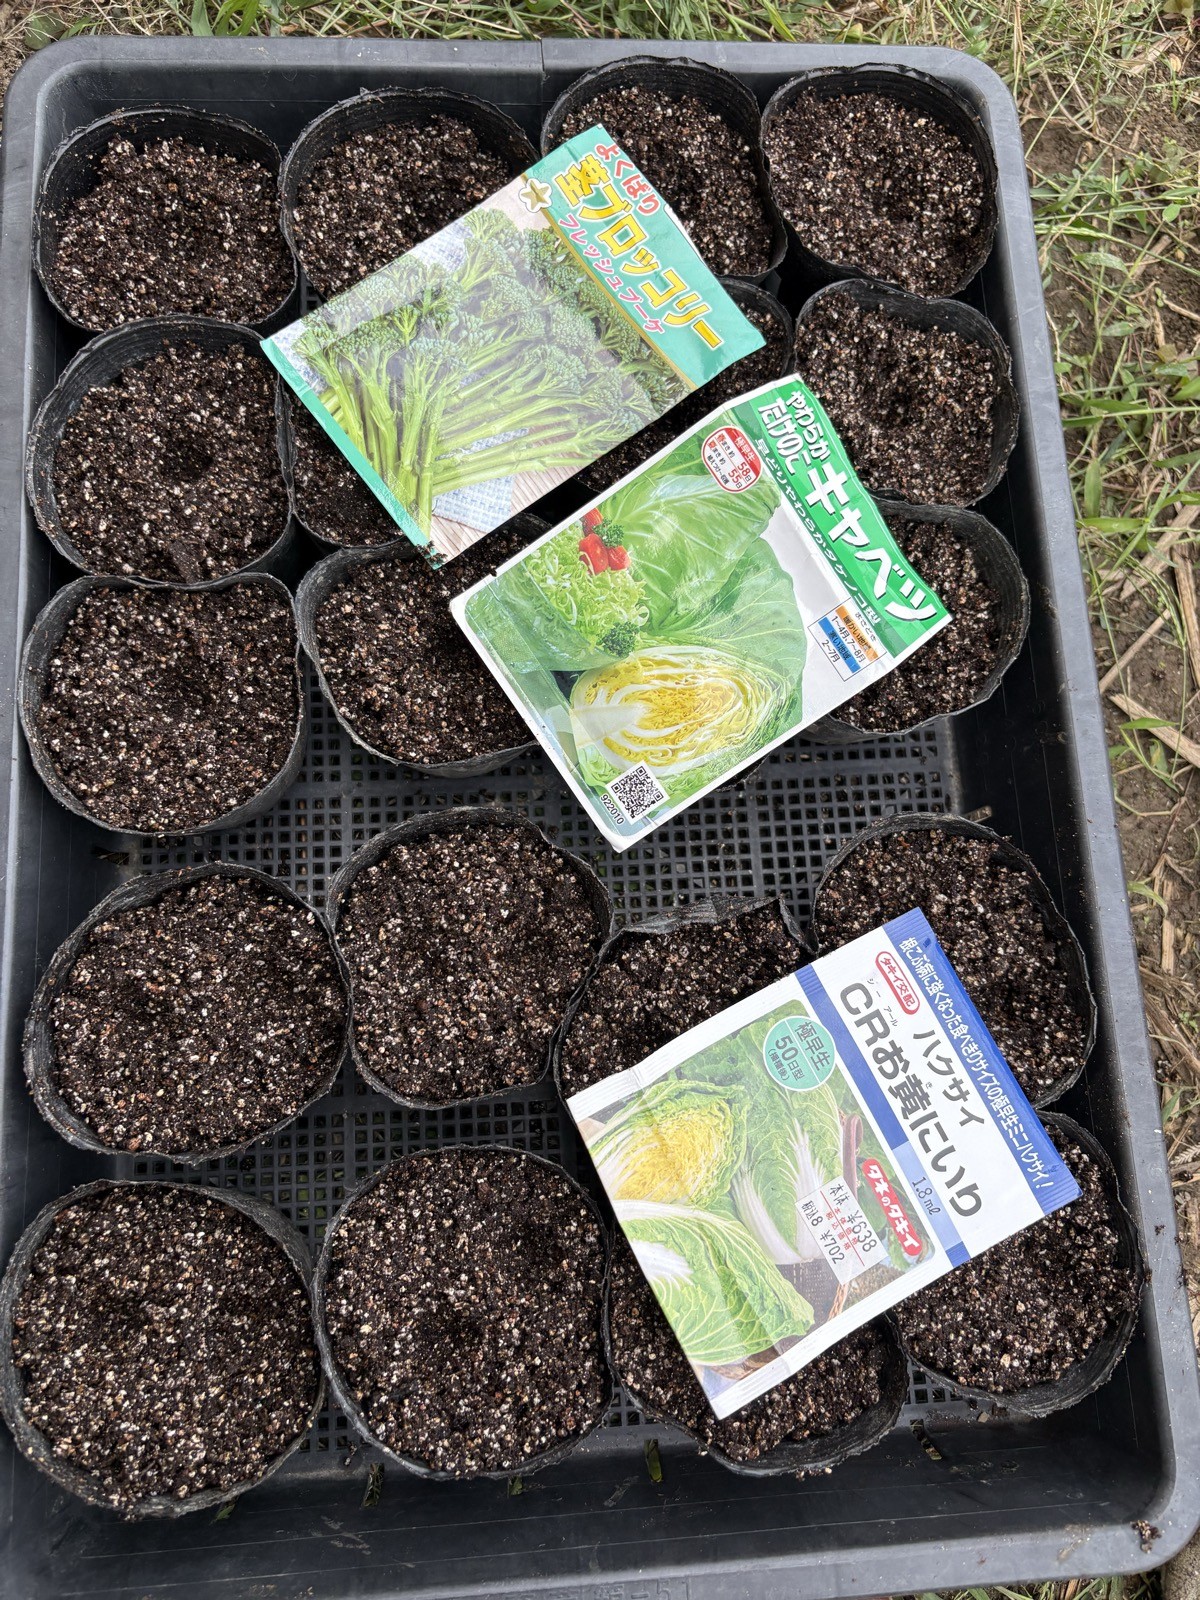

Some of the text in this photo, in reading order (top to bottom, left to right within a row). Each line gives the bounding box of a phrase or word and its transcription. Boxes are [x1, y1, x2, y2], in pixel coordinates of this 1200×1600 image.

[596, 143, 660, 214] よくばり
[555, 154, 722, 348] 茎ブロッコリー
[558, 213, 664, 334] フレッシュブーケ
[758, 397, 812, 475] たけのこ
[786, 390, 830, 460] やわらか
[727, 468, 743, 489] 55日
[737, 461, 752, 482] 58日
[754, 438, 881, 625] 早どりやわらかタケノコ型
[804, 462, 938, 621] キャベツ
[600, 793, 625, 825] 922010
[880, 956, 917, 1008] タキイ交配
[775, 1035, 806, 1081] 50日型
[794, 1021, 831, 1071] 極早生
[912, 1029, 985, 1128] ハクサイ
[839, 982, 984, 1217] CRお黄にいり
[829, 1183, 878, 1253] 本体 ¥638
[866, 1164, 920, 1248] タネのタキイ
[820, 1229, 846, 1265] ¥702
